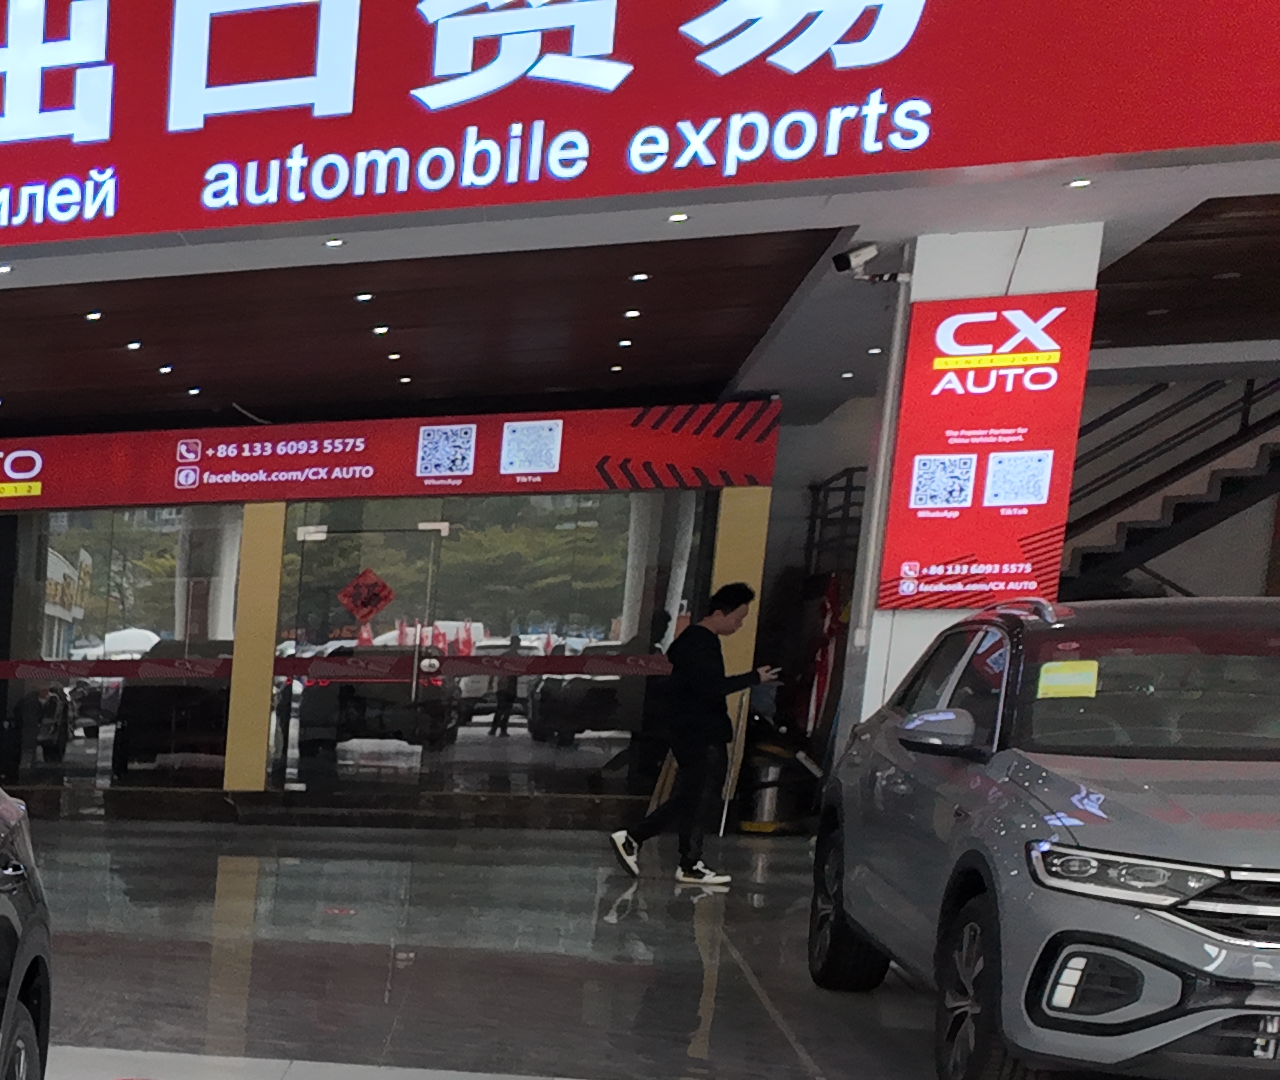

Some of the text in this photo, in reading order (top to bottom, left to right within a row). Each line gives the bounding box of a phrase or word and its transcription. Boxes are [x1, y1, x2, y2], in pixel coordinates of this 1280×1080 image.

[202, 88, 932, 210] automobile exports
[935, 306, 1067, 355] CX
[931, 367, 1058, 395] AUTO
[206, 438, 365, 457] +86 133 6093 5575
[203, 466, 374, 484] facebook.com/CX AUTO
[1002, 563, 1032, 573] 5575
[1007, 581, 1037, 590] AUTO
